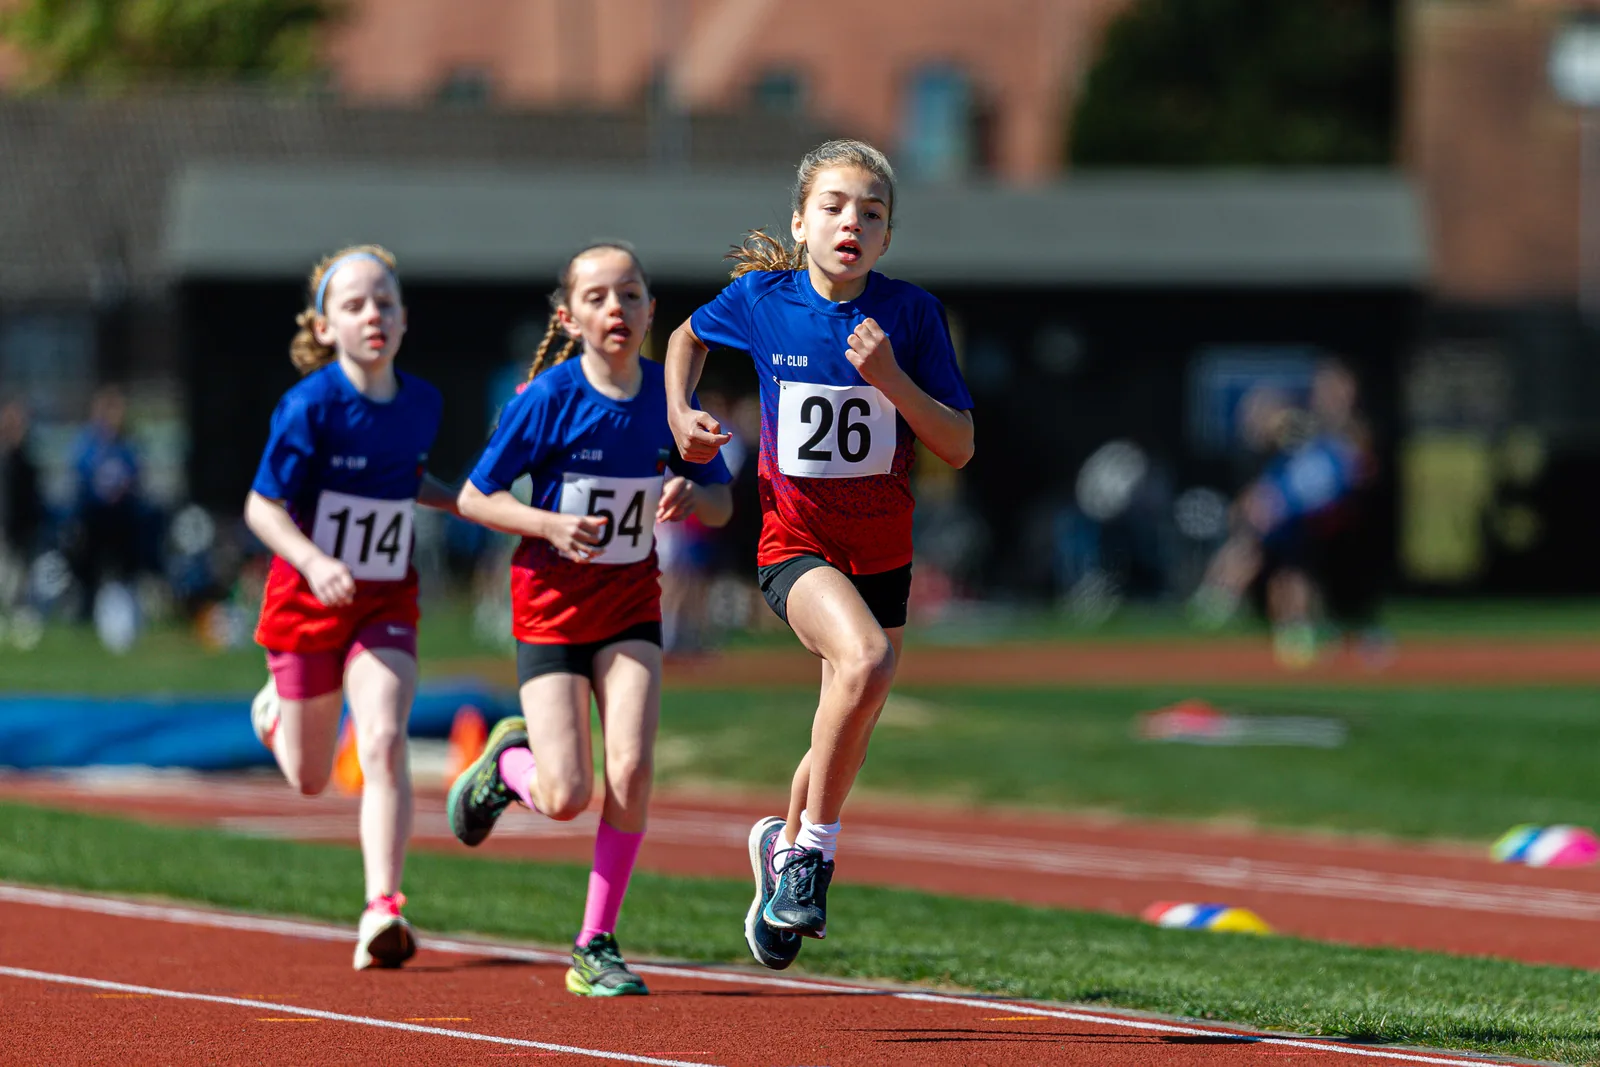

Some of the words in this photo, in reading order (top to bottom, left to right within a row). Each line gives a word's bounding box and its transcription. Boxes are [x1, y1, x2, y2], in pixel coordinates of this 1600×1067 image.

[797, 395, 871, 463] 26
[328, 506, 404, 565] 114
[587, 488, 646, 548] 54
